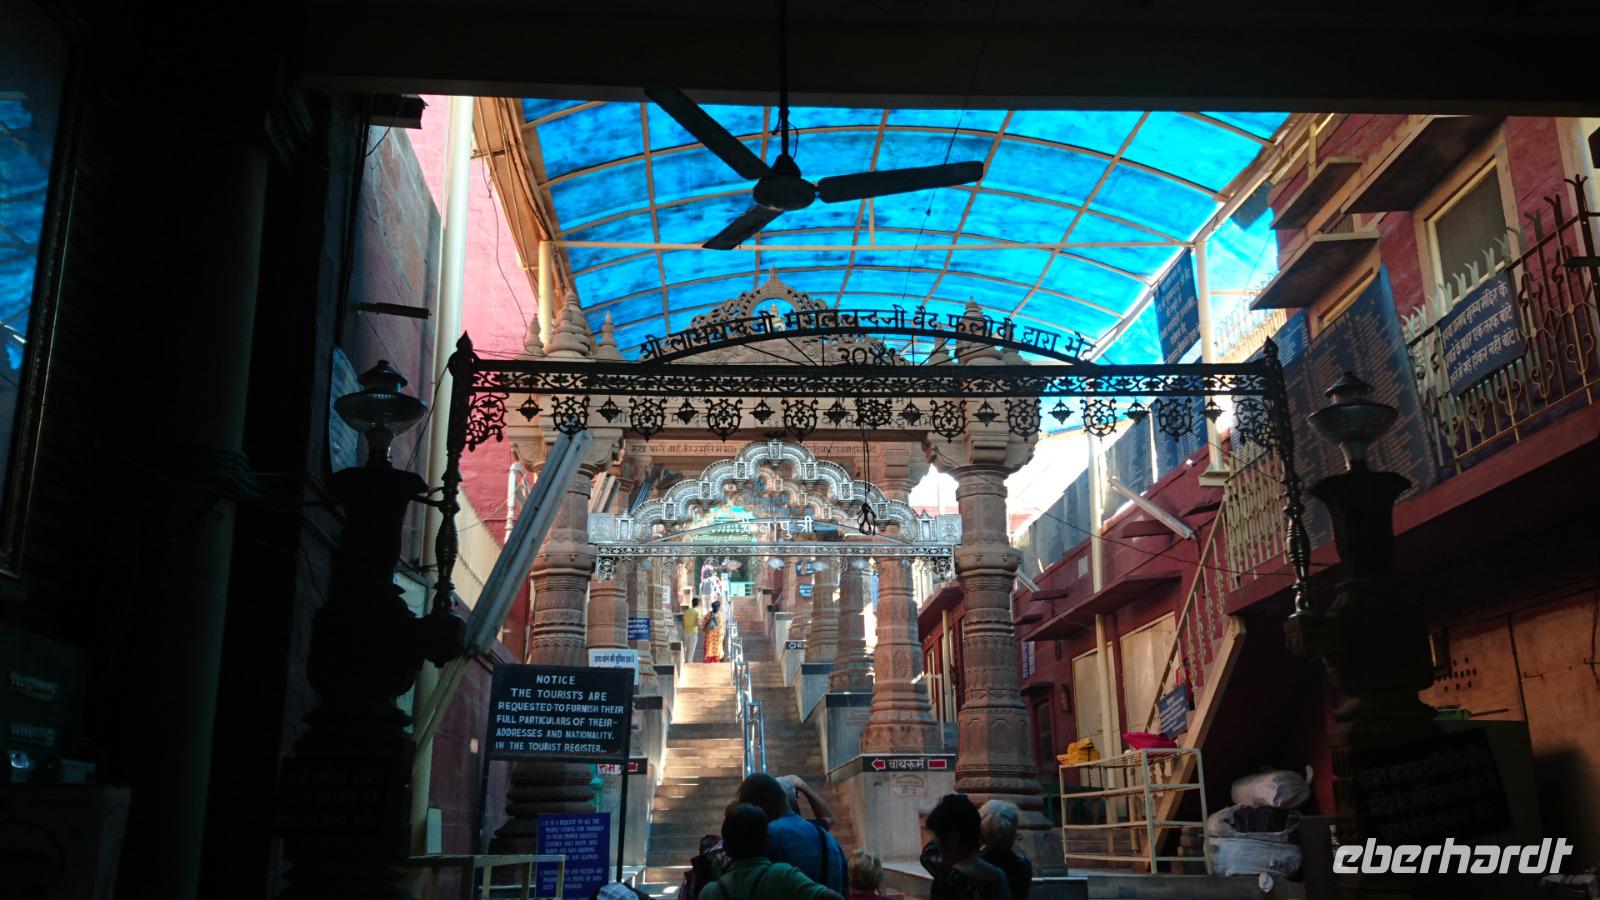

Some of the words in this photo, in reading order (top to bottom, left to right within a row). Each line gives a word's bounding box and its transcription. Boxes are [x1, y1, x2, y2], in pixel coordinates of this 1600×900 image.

[1481, 289, 1498, 309] मंदिर
[1498, 280, 1508, 297] के
[639, 333, 664, 360] श्री
[1021, 325, 1061, 351] द्वारा
[536, 675, 576, 685] NOTICE
[511, 688, 532, 697] THE
[537, 690, 583, 700] TOURISTS
[588, 692, 607, 701] ARE
[566, 704, 599, 712] FURNISH
[601, 705, 624, 714] THEIR
[497, 715, 516, 723] FULL
[519, 716, 571, 725] PARTICULARS
[573, 718, 585, 726] OF
[496, 728, 543, 737] ADDRESSES
[547, 730, 562, 738] AND
[496, 741, 504, 749] IN
[510, 742, 524, 750] THE
[529, 743, 561, 751] TOURIST
[888, 759, 925, 770] बाथरूम
